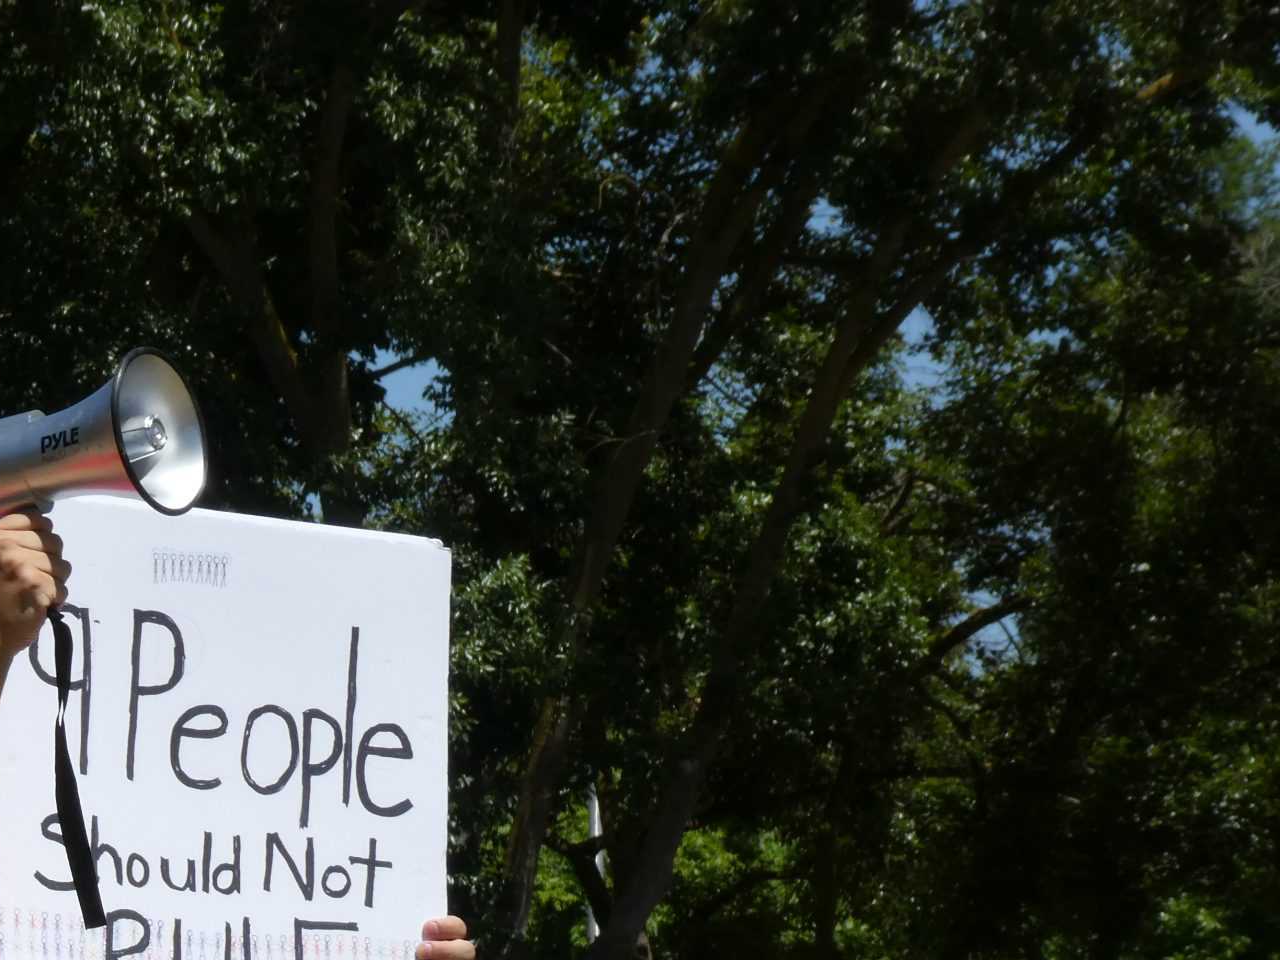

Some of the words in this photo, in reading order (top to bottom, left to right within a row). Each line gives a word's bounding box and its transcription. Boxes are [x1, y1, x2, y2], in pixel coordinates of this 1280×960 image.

[40, 427, 80, 454] PYLE
[28, 603, 91, 775] 9
[126, 608, 414, 829] People
[33, 813, 241, 895] Should
[263, 832, 393, 907] Not
